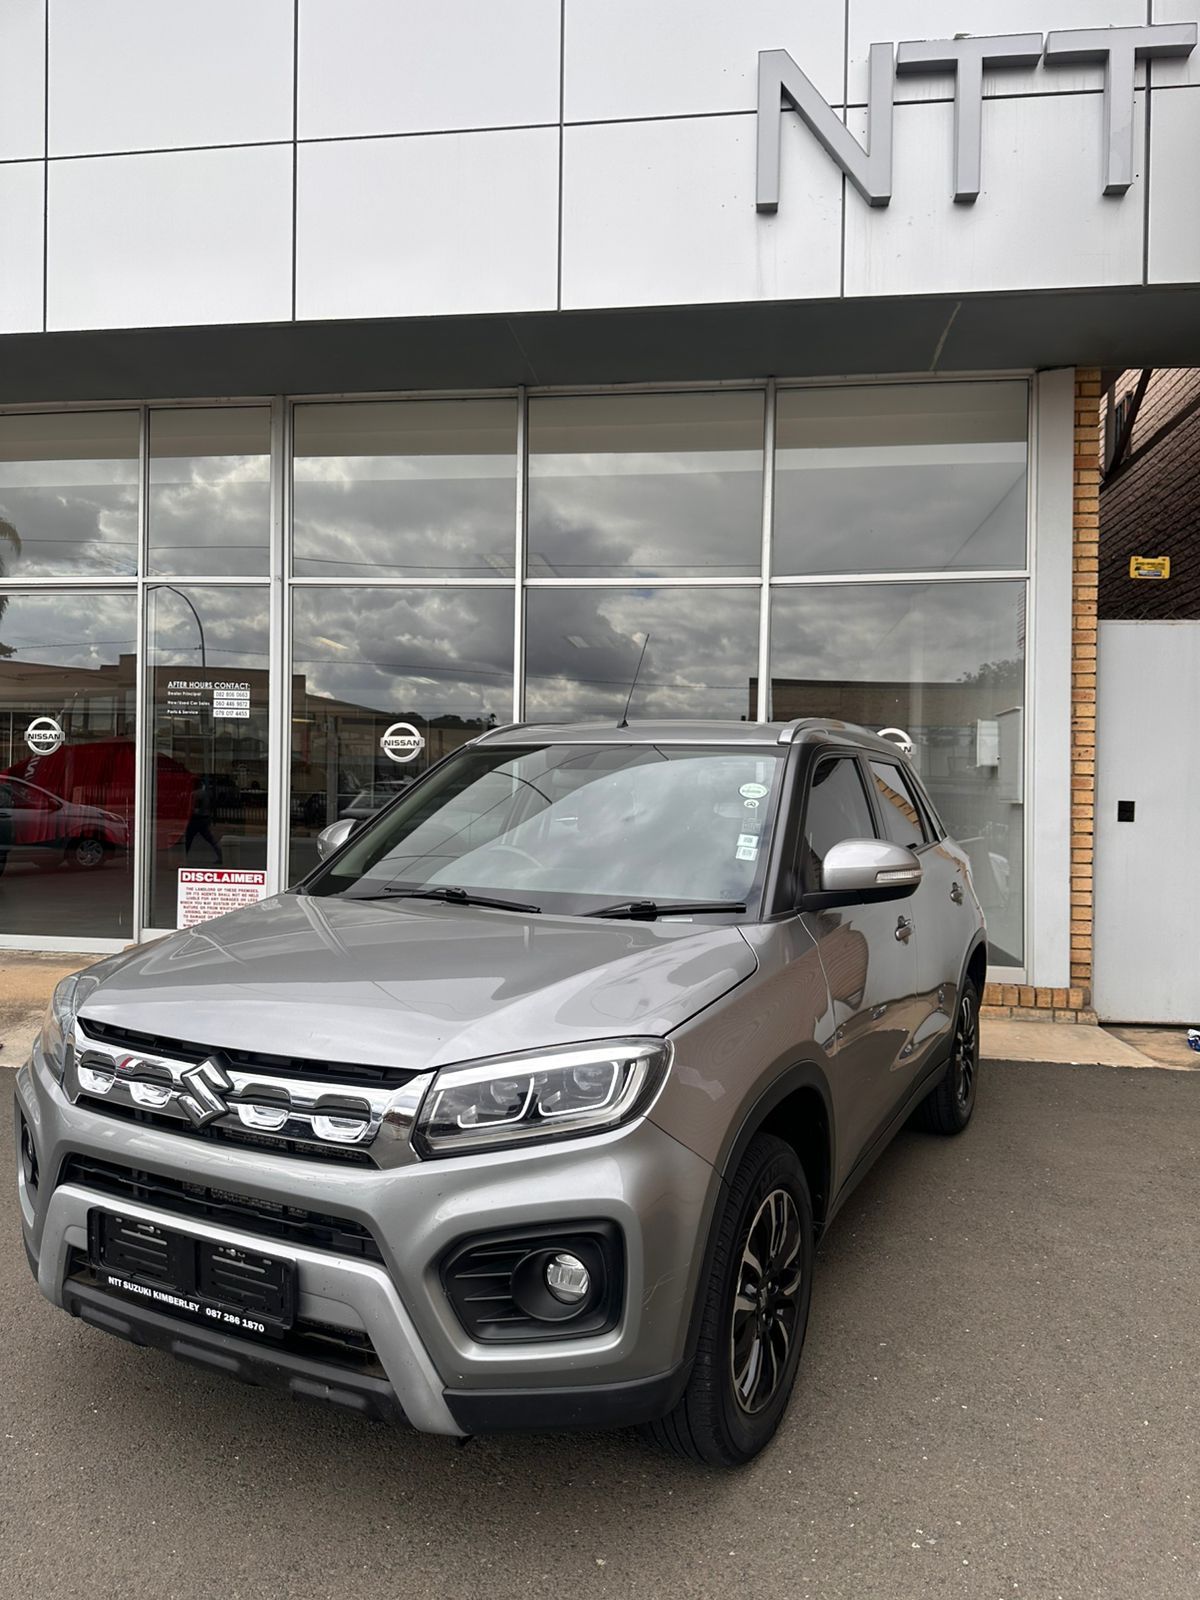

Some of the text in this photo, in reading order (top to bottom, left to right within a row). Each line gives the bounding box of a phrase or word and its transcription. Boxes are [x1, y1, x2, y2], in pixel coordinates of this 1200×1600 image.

[756, 22, 1198, 214] NTT
[182, 872, 264, 884] DISCLAIMER
[108, 1276, 265, 1332] NTT SUZUKI KIMBERLEY 087 286 1870
